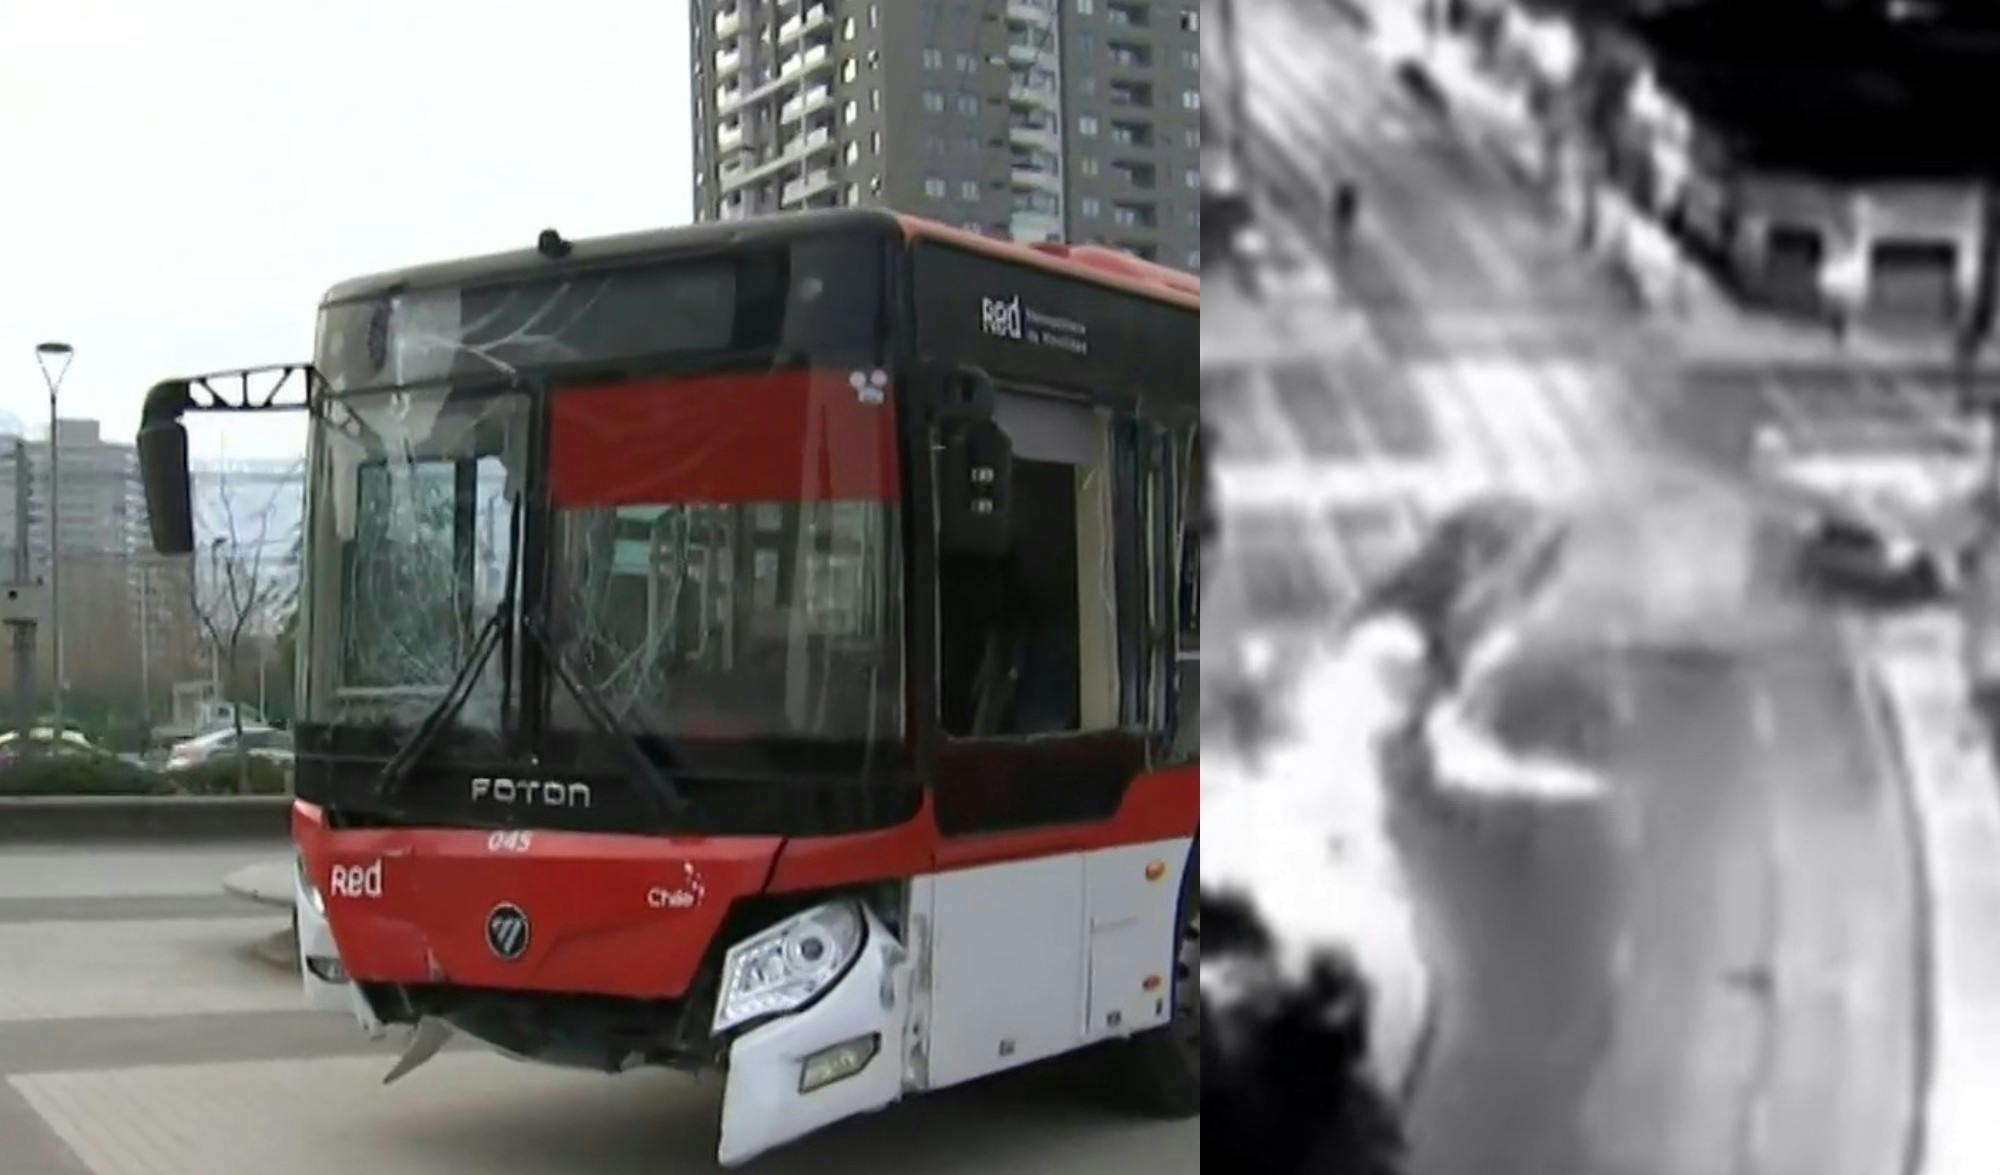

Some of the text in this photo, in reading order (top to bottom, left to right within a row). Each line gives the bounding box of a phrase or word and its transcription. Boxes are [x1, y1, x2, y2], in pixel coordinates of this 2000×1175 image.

[982, 294, 1021, 339] Red
[471, 778, 591, 807] FOTON
[488, 830, 532, 852] 045
[331, 858, 382, 898] Red
